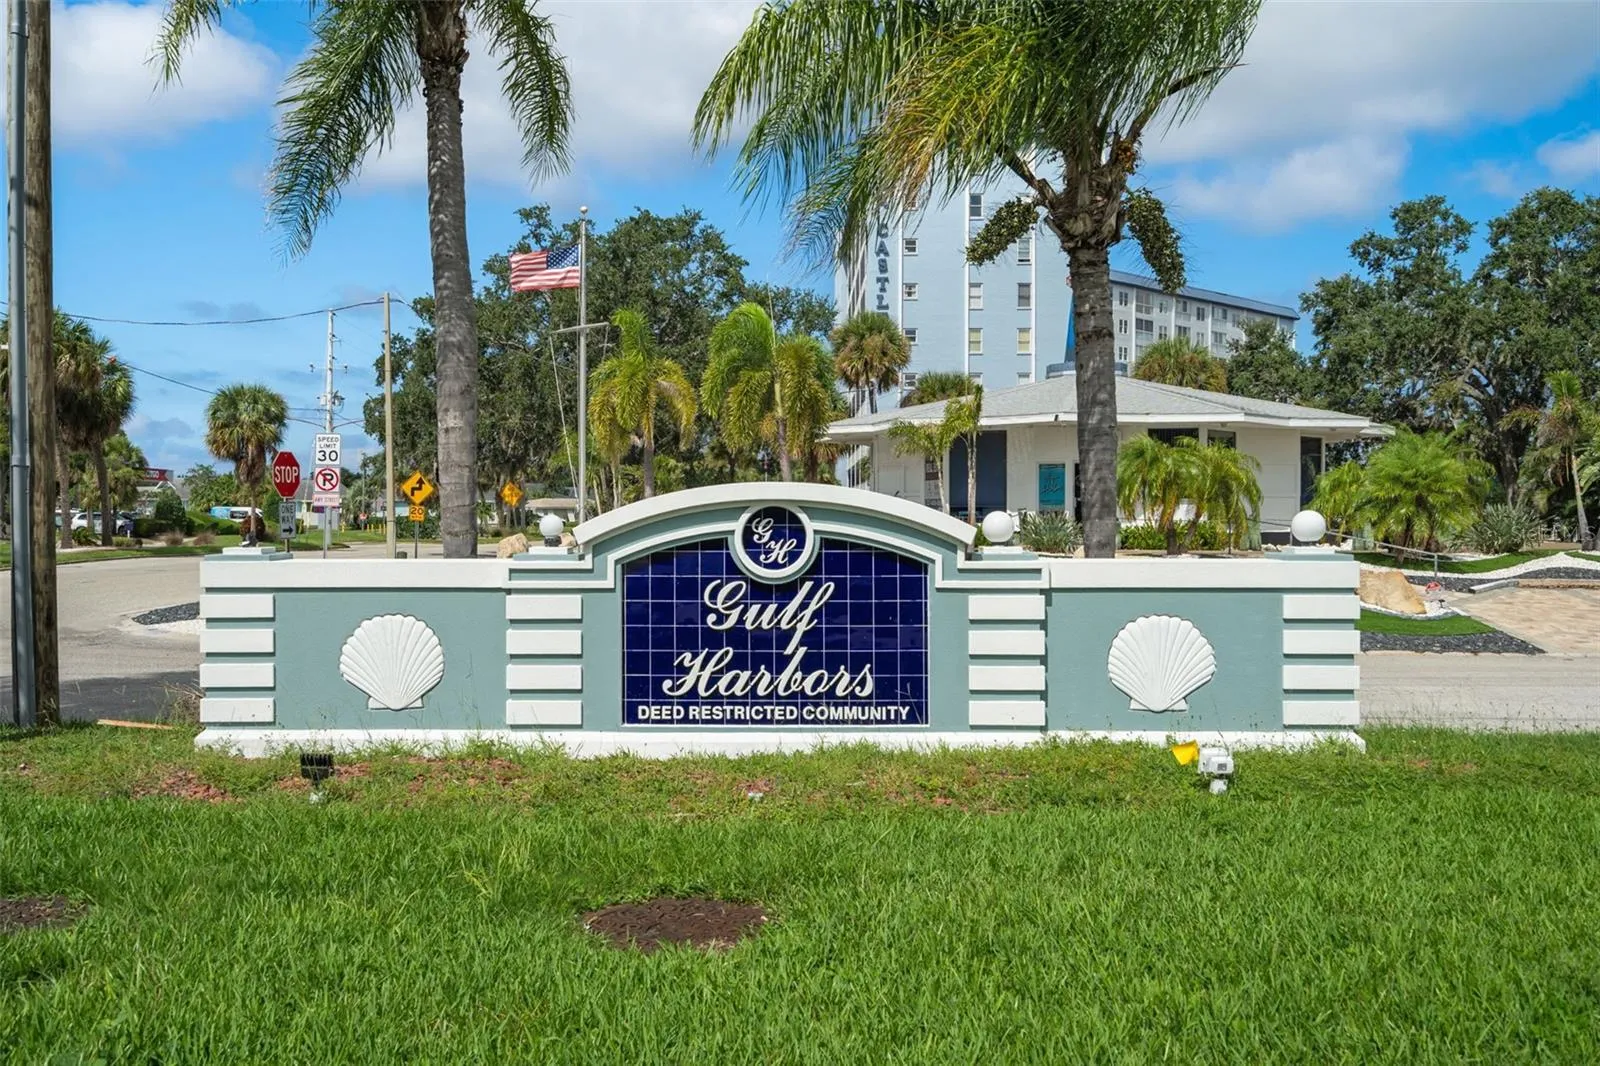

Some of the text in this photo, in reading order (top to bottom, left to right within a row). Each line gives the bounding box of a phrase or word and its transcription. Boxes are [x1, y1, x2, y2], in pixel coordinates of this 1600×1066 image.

[875, 222, 890, 319] CASTL
[317, 450, 339, 462] 30
[274, 466, 299, 484] STOP
[281, 504, 295, 514] ONE
[410, 506, 424, 516] 20
[281, 515, 295, 525] WAY
[703, 579, 835, 655] Gulf
[662, 646, 874, 697] Harbors
[637, 706, 910, 720] DEED RESTRICTED COMMUNITY
